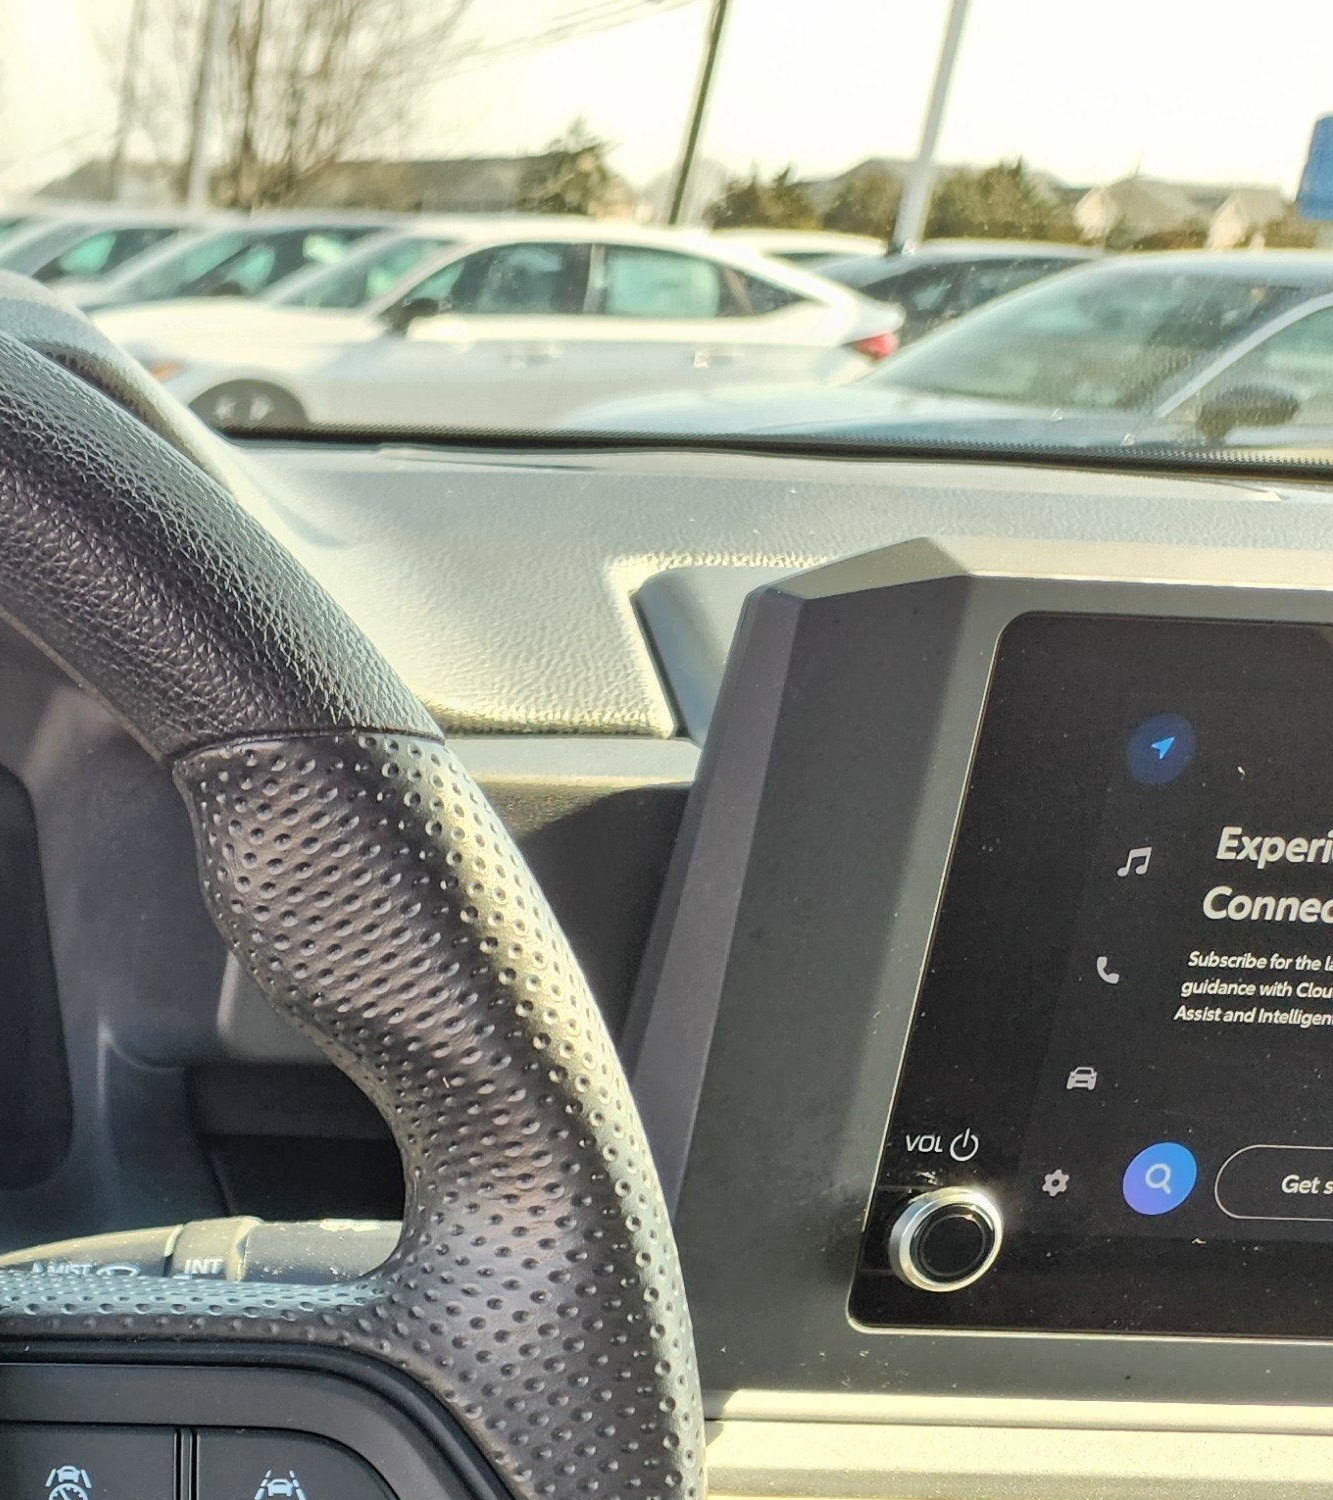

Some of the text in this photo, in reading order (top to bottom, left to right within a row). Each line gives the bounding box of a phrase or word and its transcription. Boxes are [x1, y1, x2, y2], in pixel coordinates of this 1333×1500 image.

[1188, 951, 1267, 970] Subscribe
[1270, 953, 1293, 970] for
[1295, 955, 1321, 972] the
[1181, 979, 1256, 997] guidance
[1259, 981, 1292, 997] with
[1174, 1005, 1222, 1022] Assist
[1223, 1007, 1256, 1023] and
[905, 1133, 944, 1154] VOL
[1281, 1174, 1321, 1194] Get
[47, 1264, 92, 1275] MIST
[184, 1258, 225, 1275] INT
